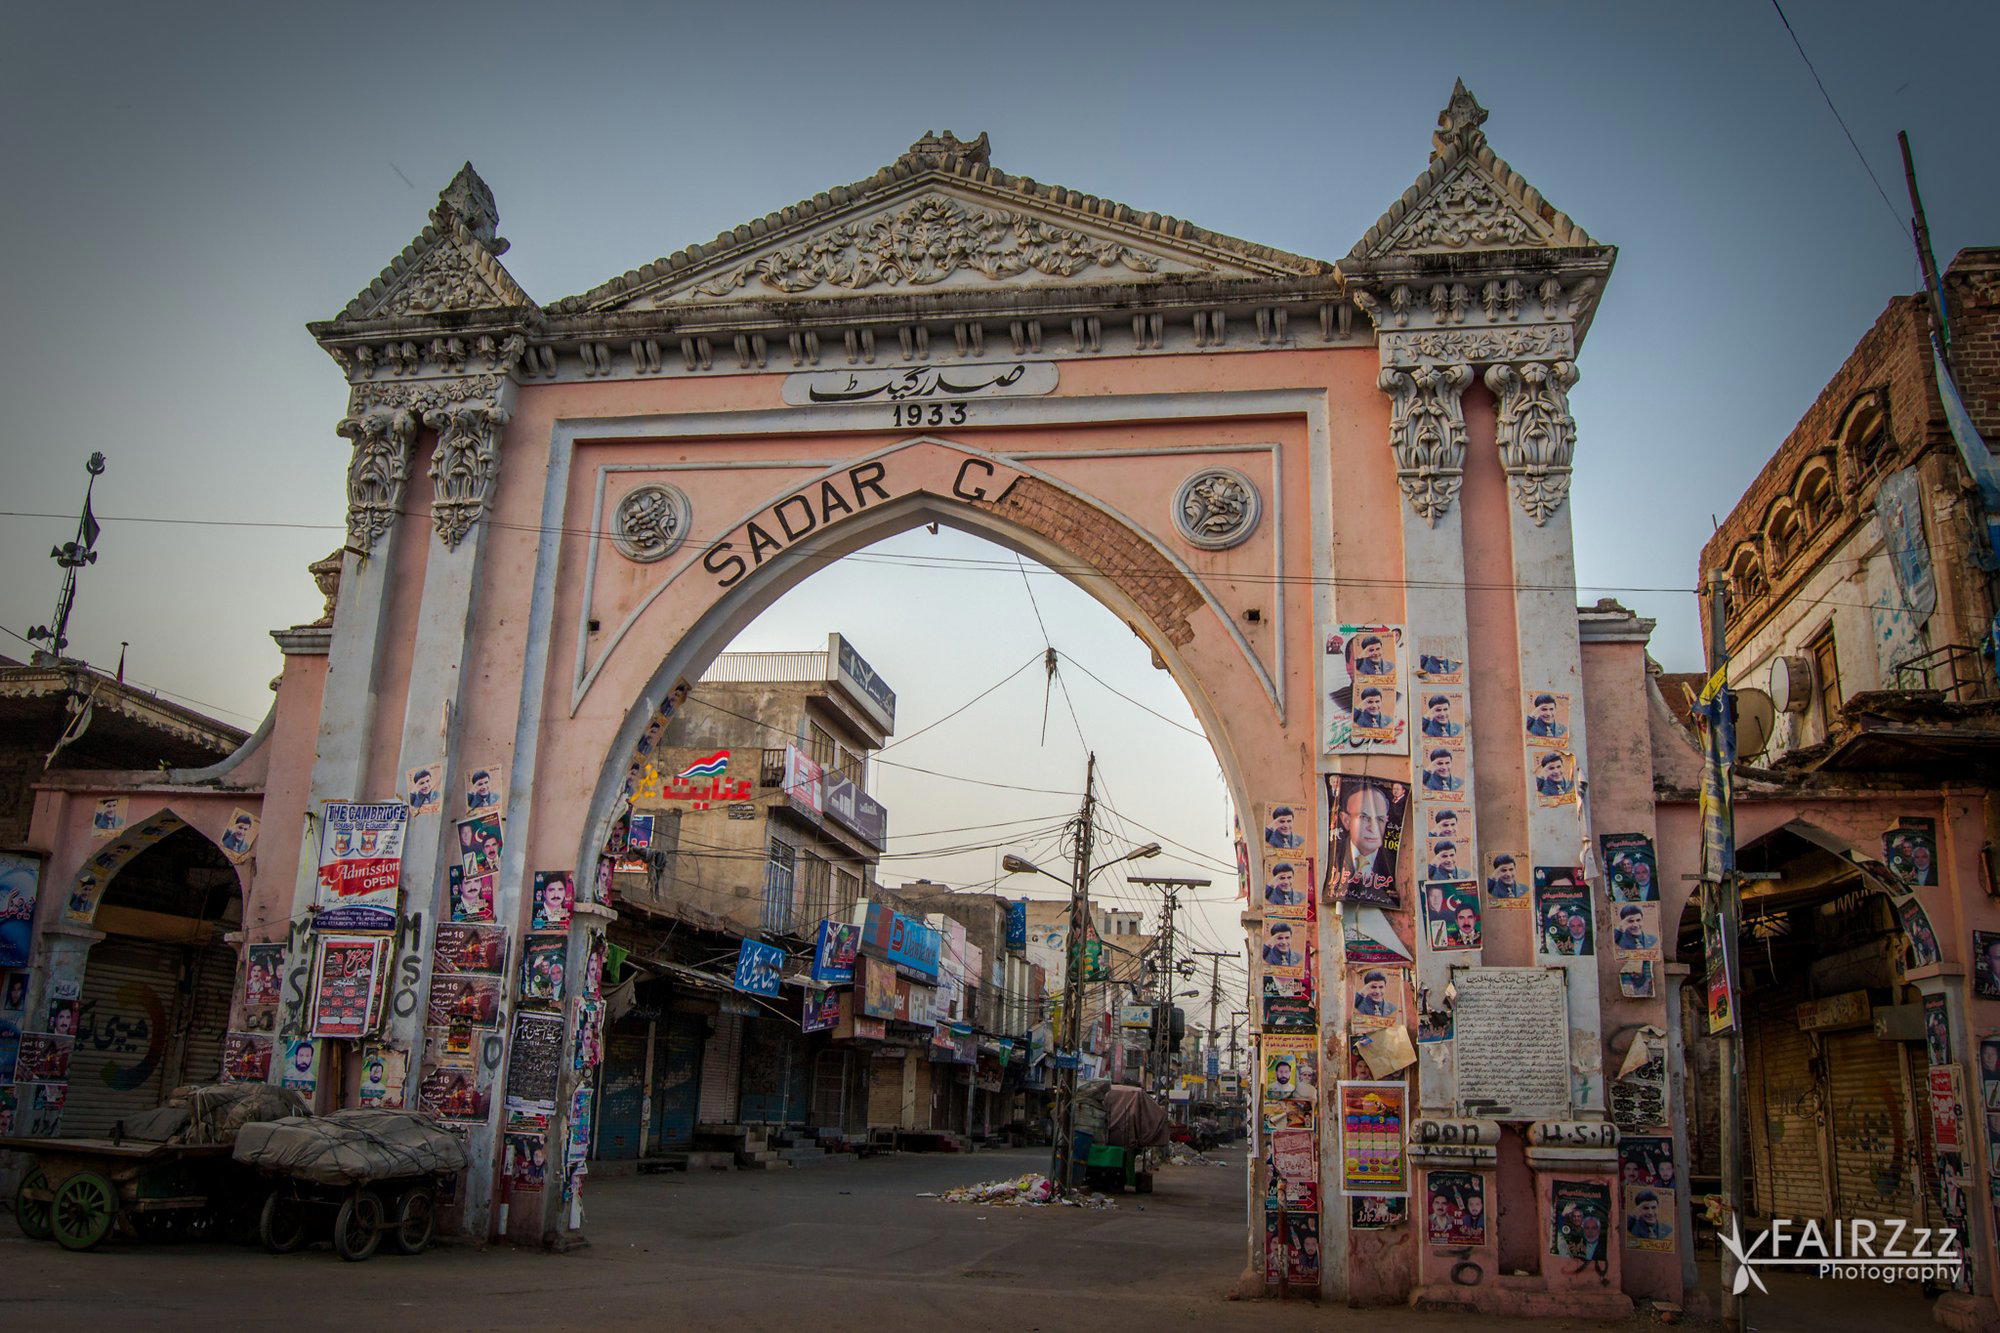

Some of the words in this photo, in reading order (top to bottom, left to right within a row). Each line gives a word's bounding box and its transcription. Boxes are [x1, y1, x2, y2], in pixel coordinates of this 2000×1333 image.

[809, 364, 933, 402] گیٹ
[906, 364, 1026, 397] صدر
[893, 402, 968, 427] 1933
[703, 461, 891, 588] SADAR
[328, 805, 348, 822] THE
[328, 859, 400, 883] Admission
[363, 874, 395, 888] OPEN
